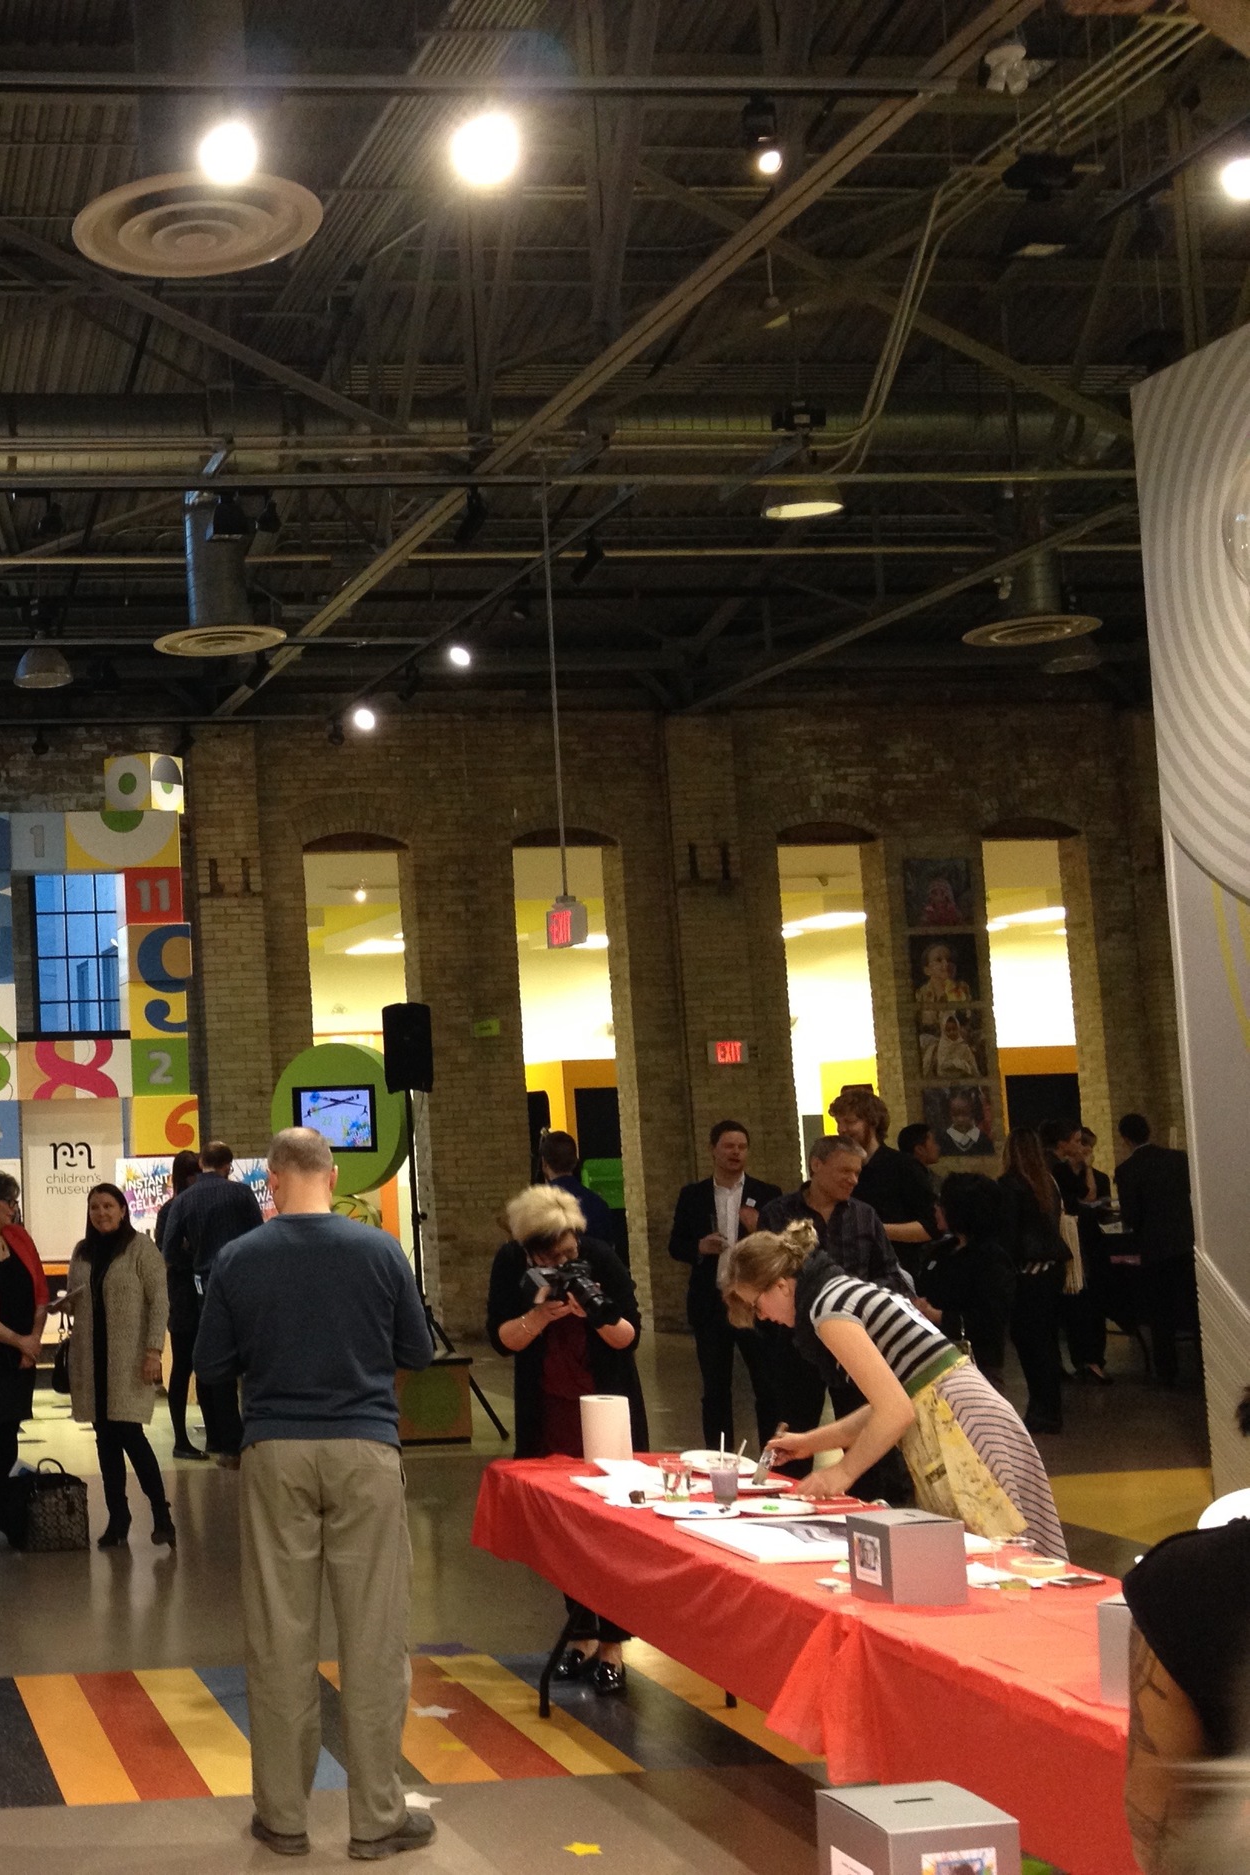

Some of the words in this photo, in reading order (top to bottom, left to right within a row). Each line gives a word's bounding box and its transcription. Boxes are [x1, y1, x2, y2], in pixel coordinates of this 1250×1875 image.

[30, 825, 45, 858] 1
[135, 878, 171, 913] 11
[716, 1041, 742, 1064] EXIT
[147, 1051, 173, 1085] 2
[45, 1172, 102, 1184] children's
[125, 1174, 168, 1191] INSTANT
[46, 1185, 94, 1195] museu
[133, 1185, 163, 1200] WINE
